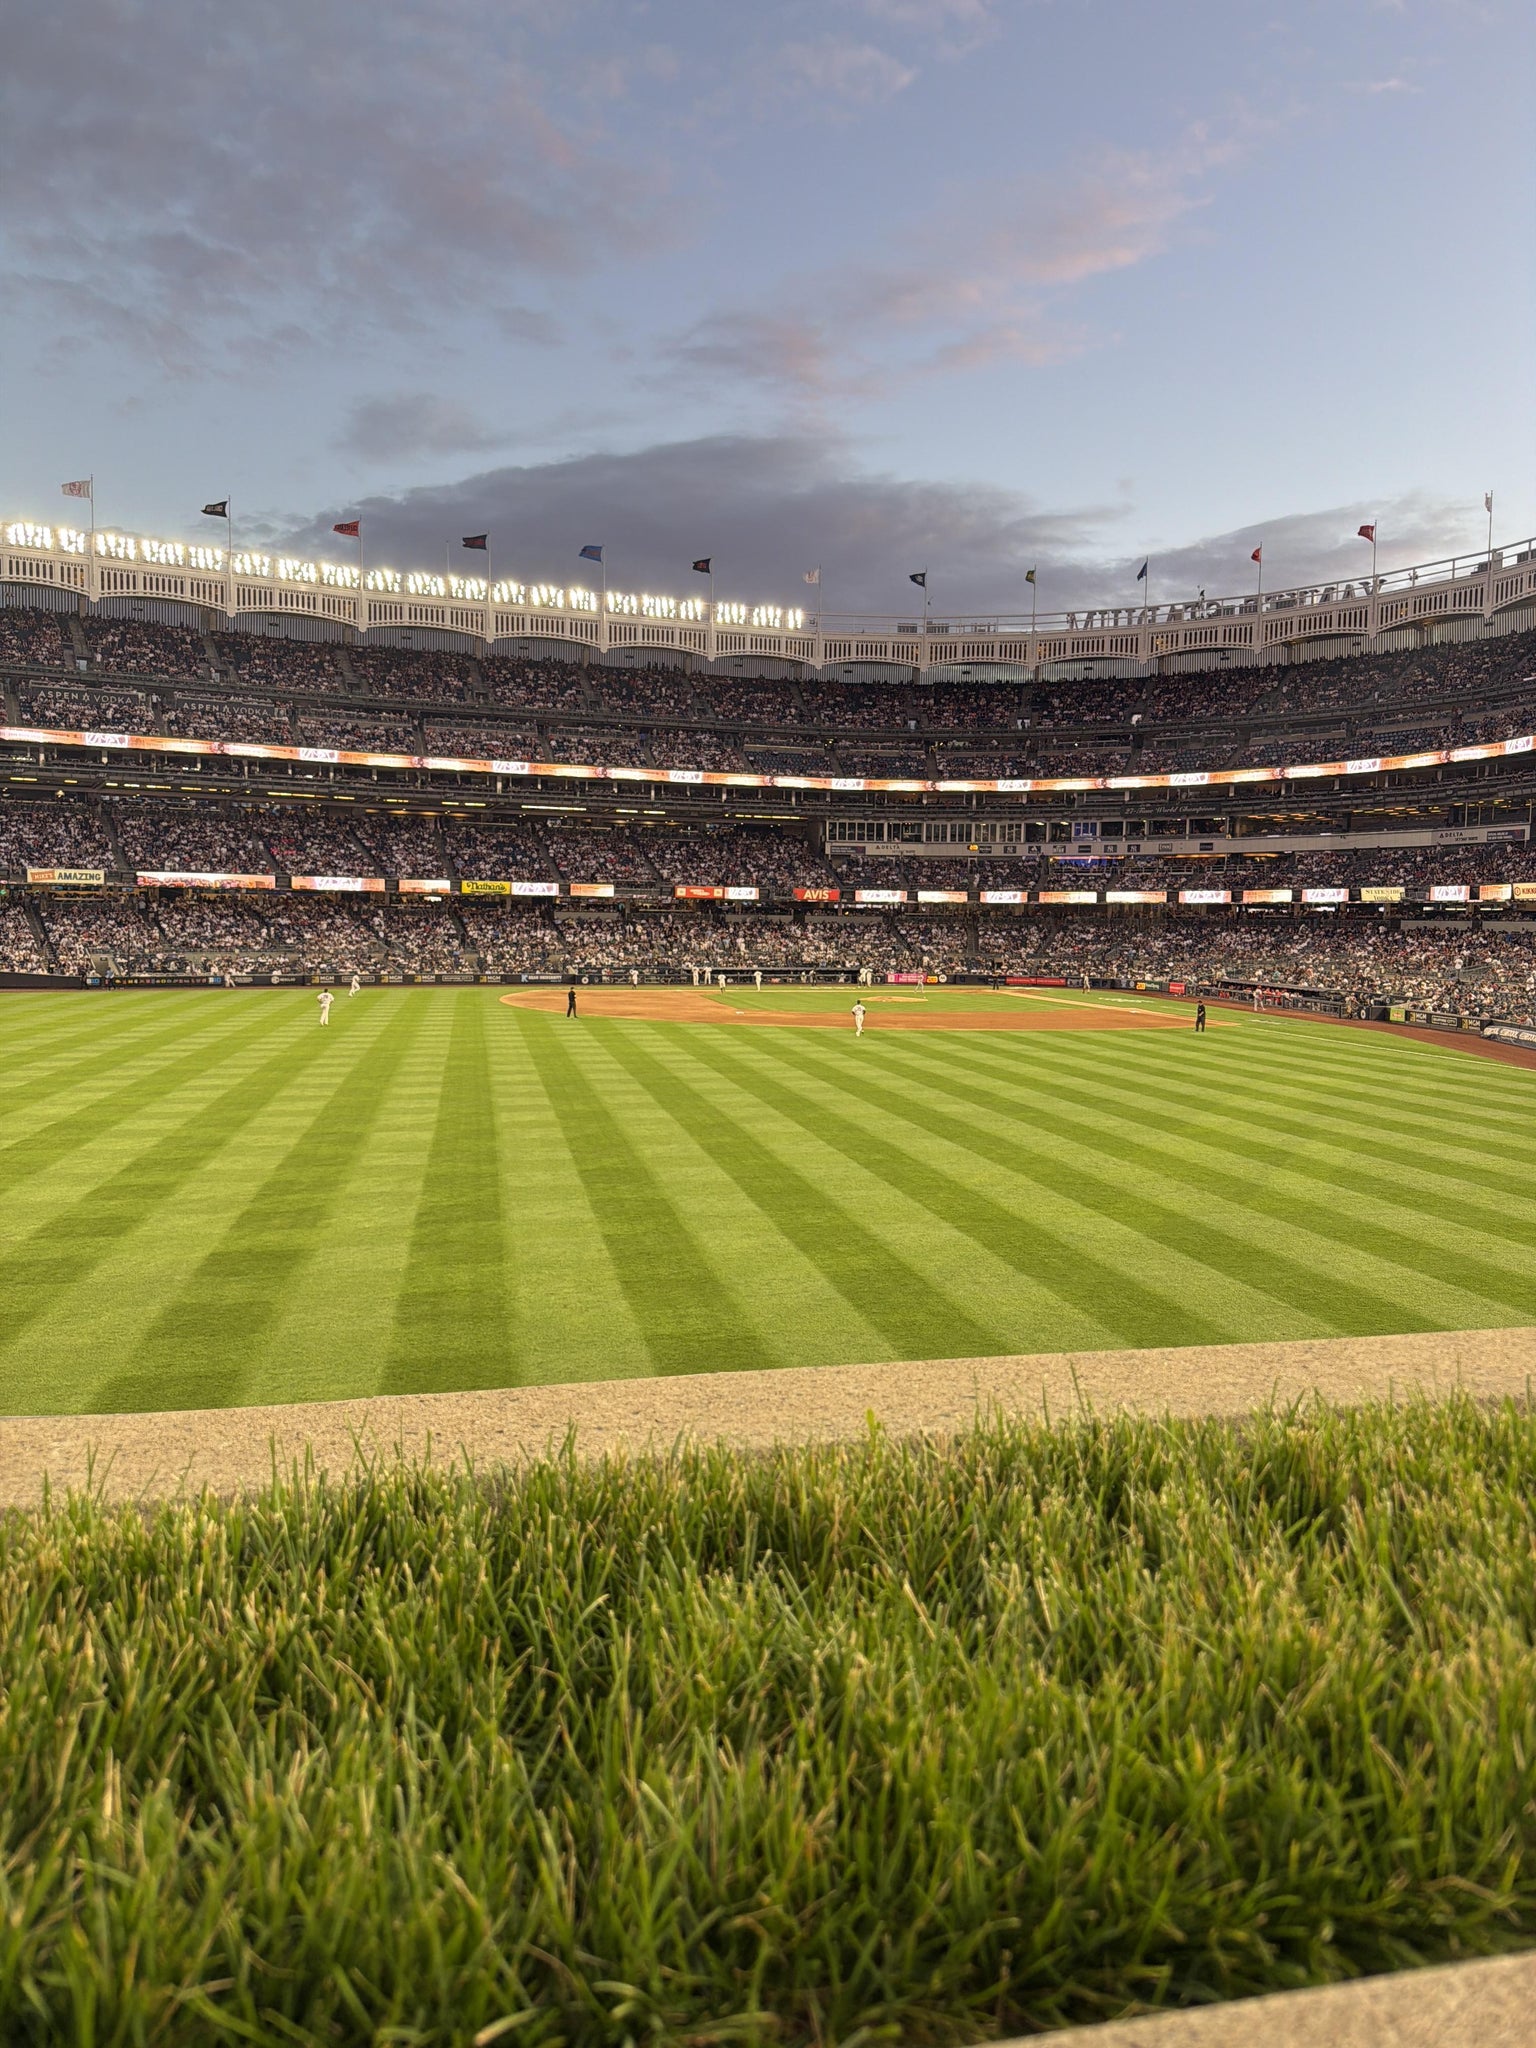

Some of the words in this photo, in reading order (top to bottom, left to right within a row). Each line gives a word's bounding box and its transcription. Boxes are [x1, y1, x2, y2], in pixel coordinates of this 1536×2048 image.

[39, 690, 79, 700] ASPEN
[93, 694, 132, 704] VODKA
[183, 702, 219, 712] ASPEN
[232, 706, 269, 716] VODKA
[1155, 806, 1178, 814] World
[1179, 805, 1216, 814] Champions
[57, 872, 102, 881] AMAZING
[466, 882, 507, 892] Nathan's
[803, 889, 829, 900] AVIS
